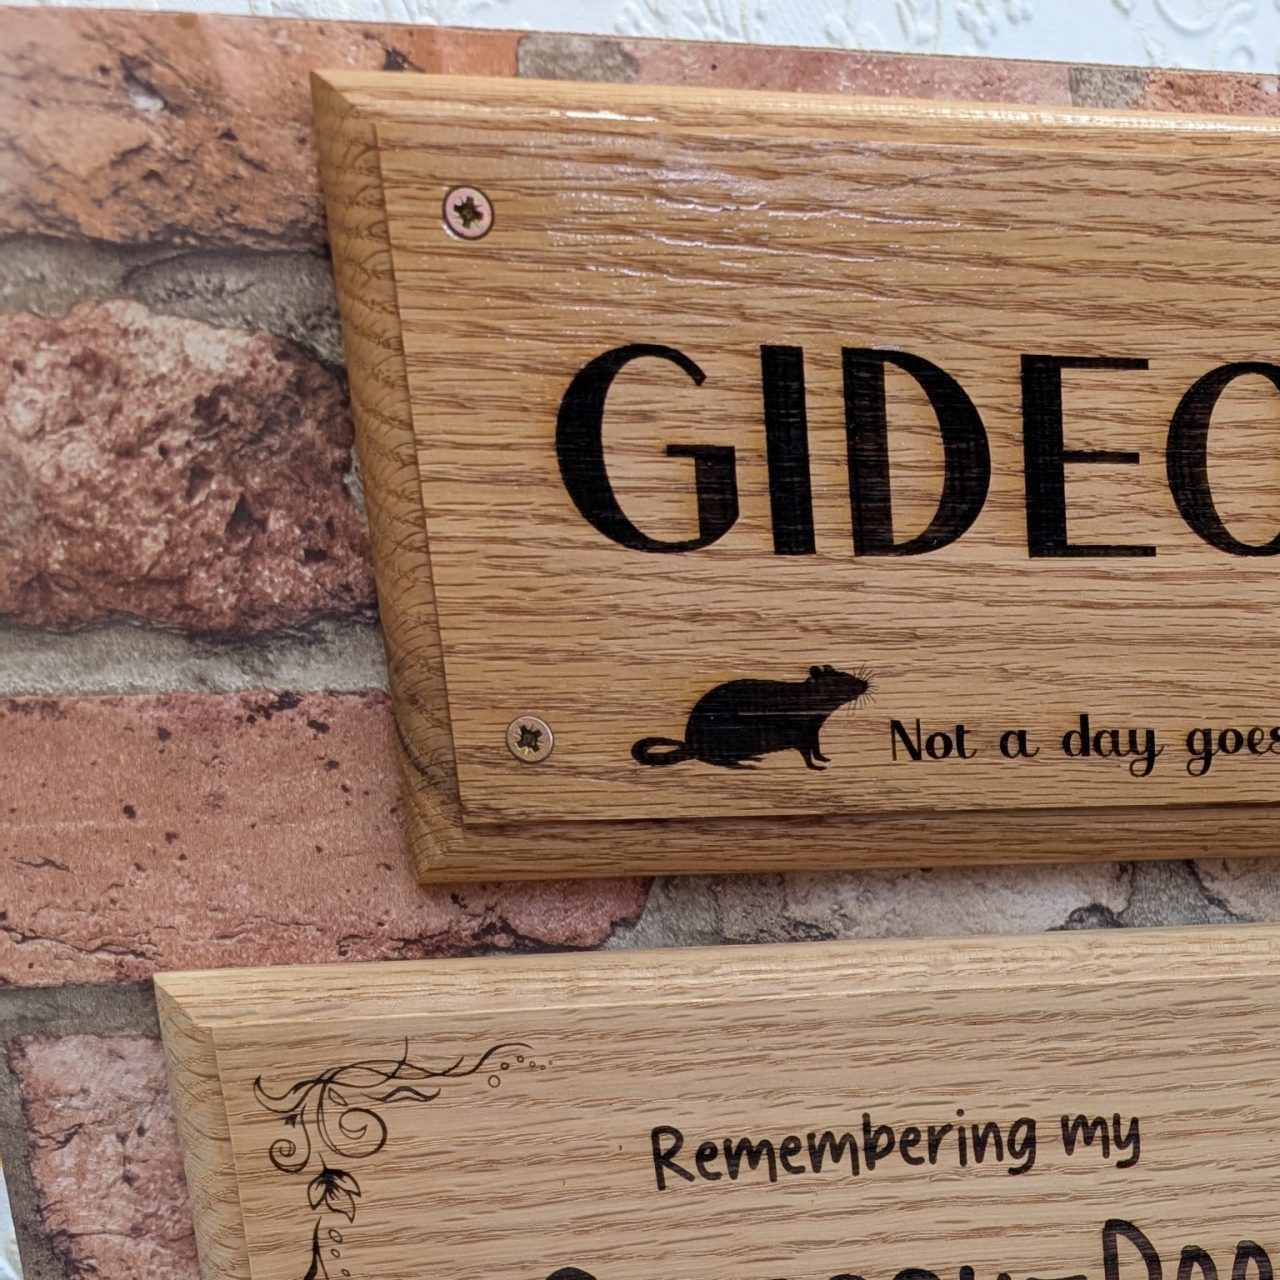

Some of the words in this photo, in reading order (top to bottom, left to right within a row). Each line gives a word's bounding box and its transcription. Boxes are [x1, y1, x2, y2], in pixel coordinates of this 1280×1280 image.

[890, 718, 977, 762] Not
[1000, 728, 1039, 759] a
[1062, 714, 1164, 777] day
[652, 1109, 1036, 1191] Remembering
[1062, 1111, 1141, 1167] my
